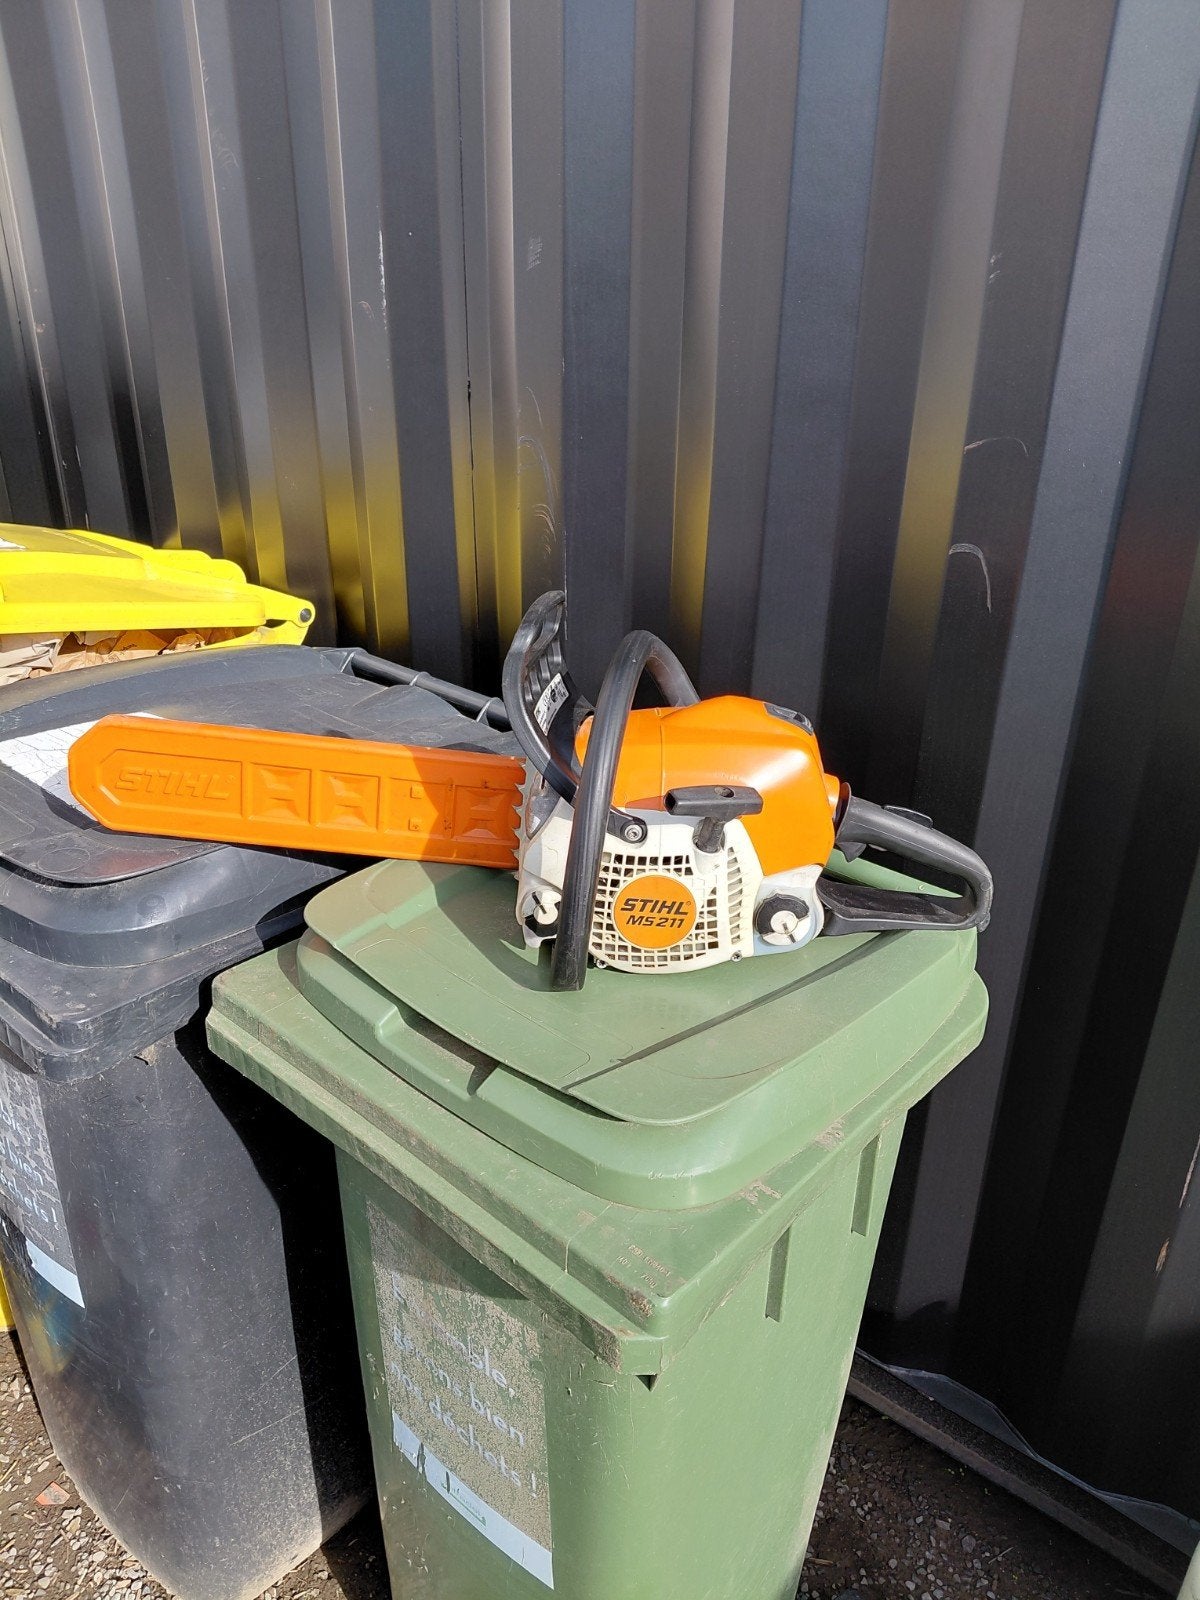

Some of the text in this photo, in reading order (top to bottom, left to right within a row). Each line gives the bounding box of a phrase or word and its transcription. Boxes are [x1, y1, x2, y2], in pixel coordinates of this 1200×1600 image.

[115, 766, 230, 801] STIHL
[620, 897, 689, 916] STIHL
[626, 915, 685, 929] MS 211
[468, 1380, 525, 1449] bien
